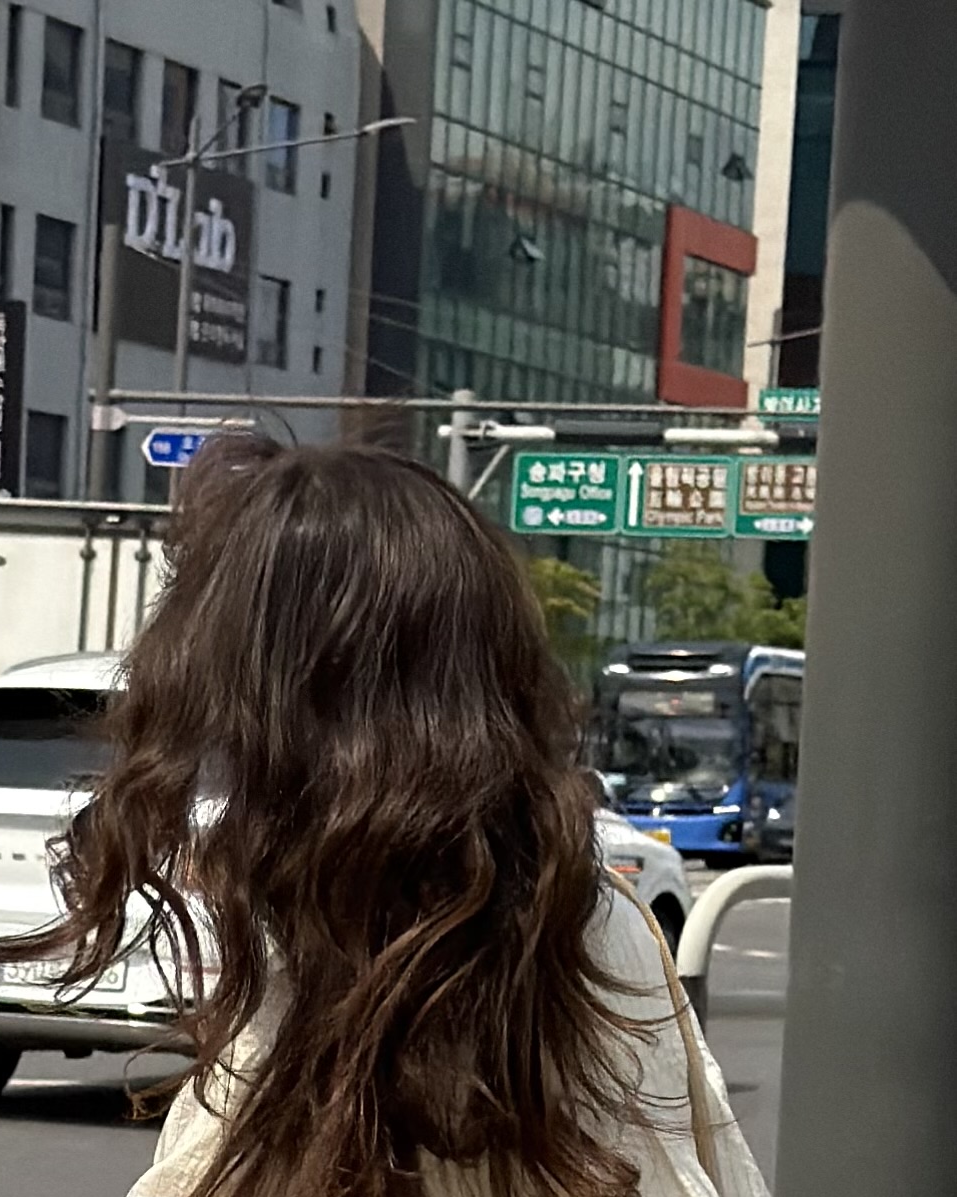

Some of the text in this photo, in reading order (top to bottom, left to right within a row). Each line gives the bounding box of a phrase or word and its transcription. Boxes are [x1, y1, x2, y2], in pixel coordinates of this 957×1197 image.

[528, 460, 607, 484] 송파구청
[650, 465, 727, 489] 올림픽공원
[578, 484, 614, 500] Office
[696, 509, 723, 525] Park
